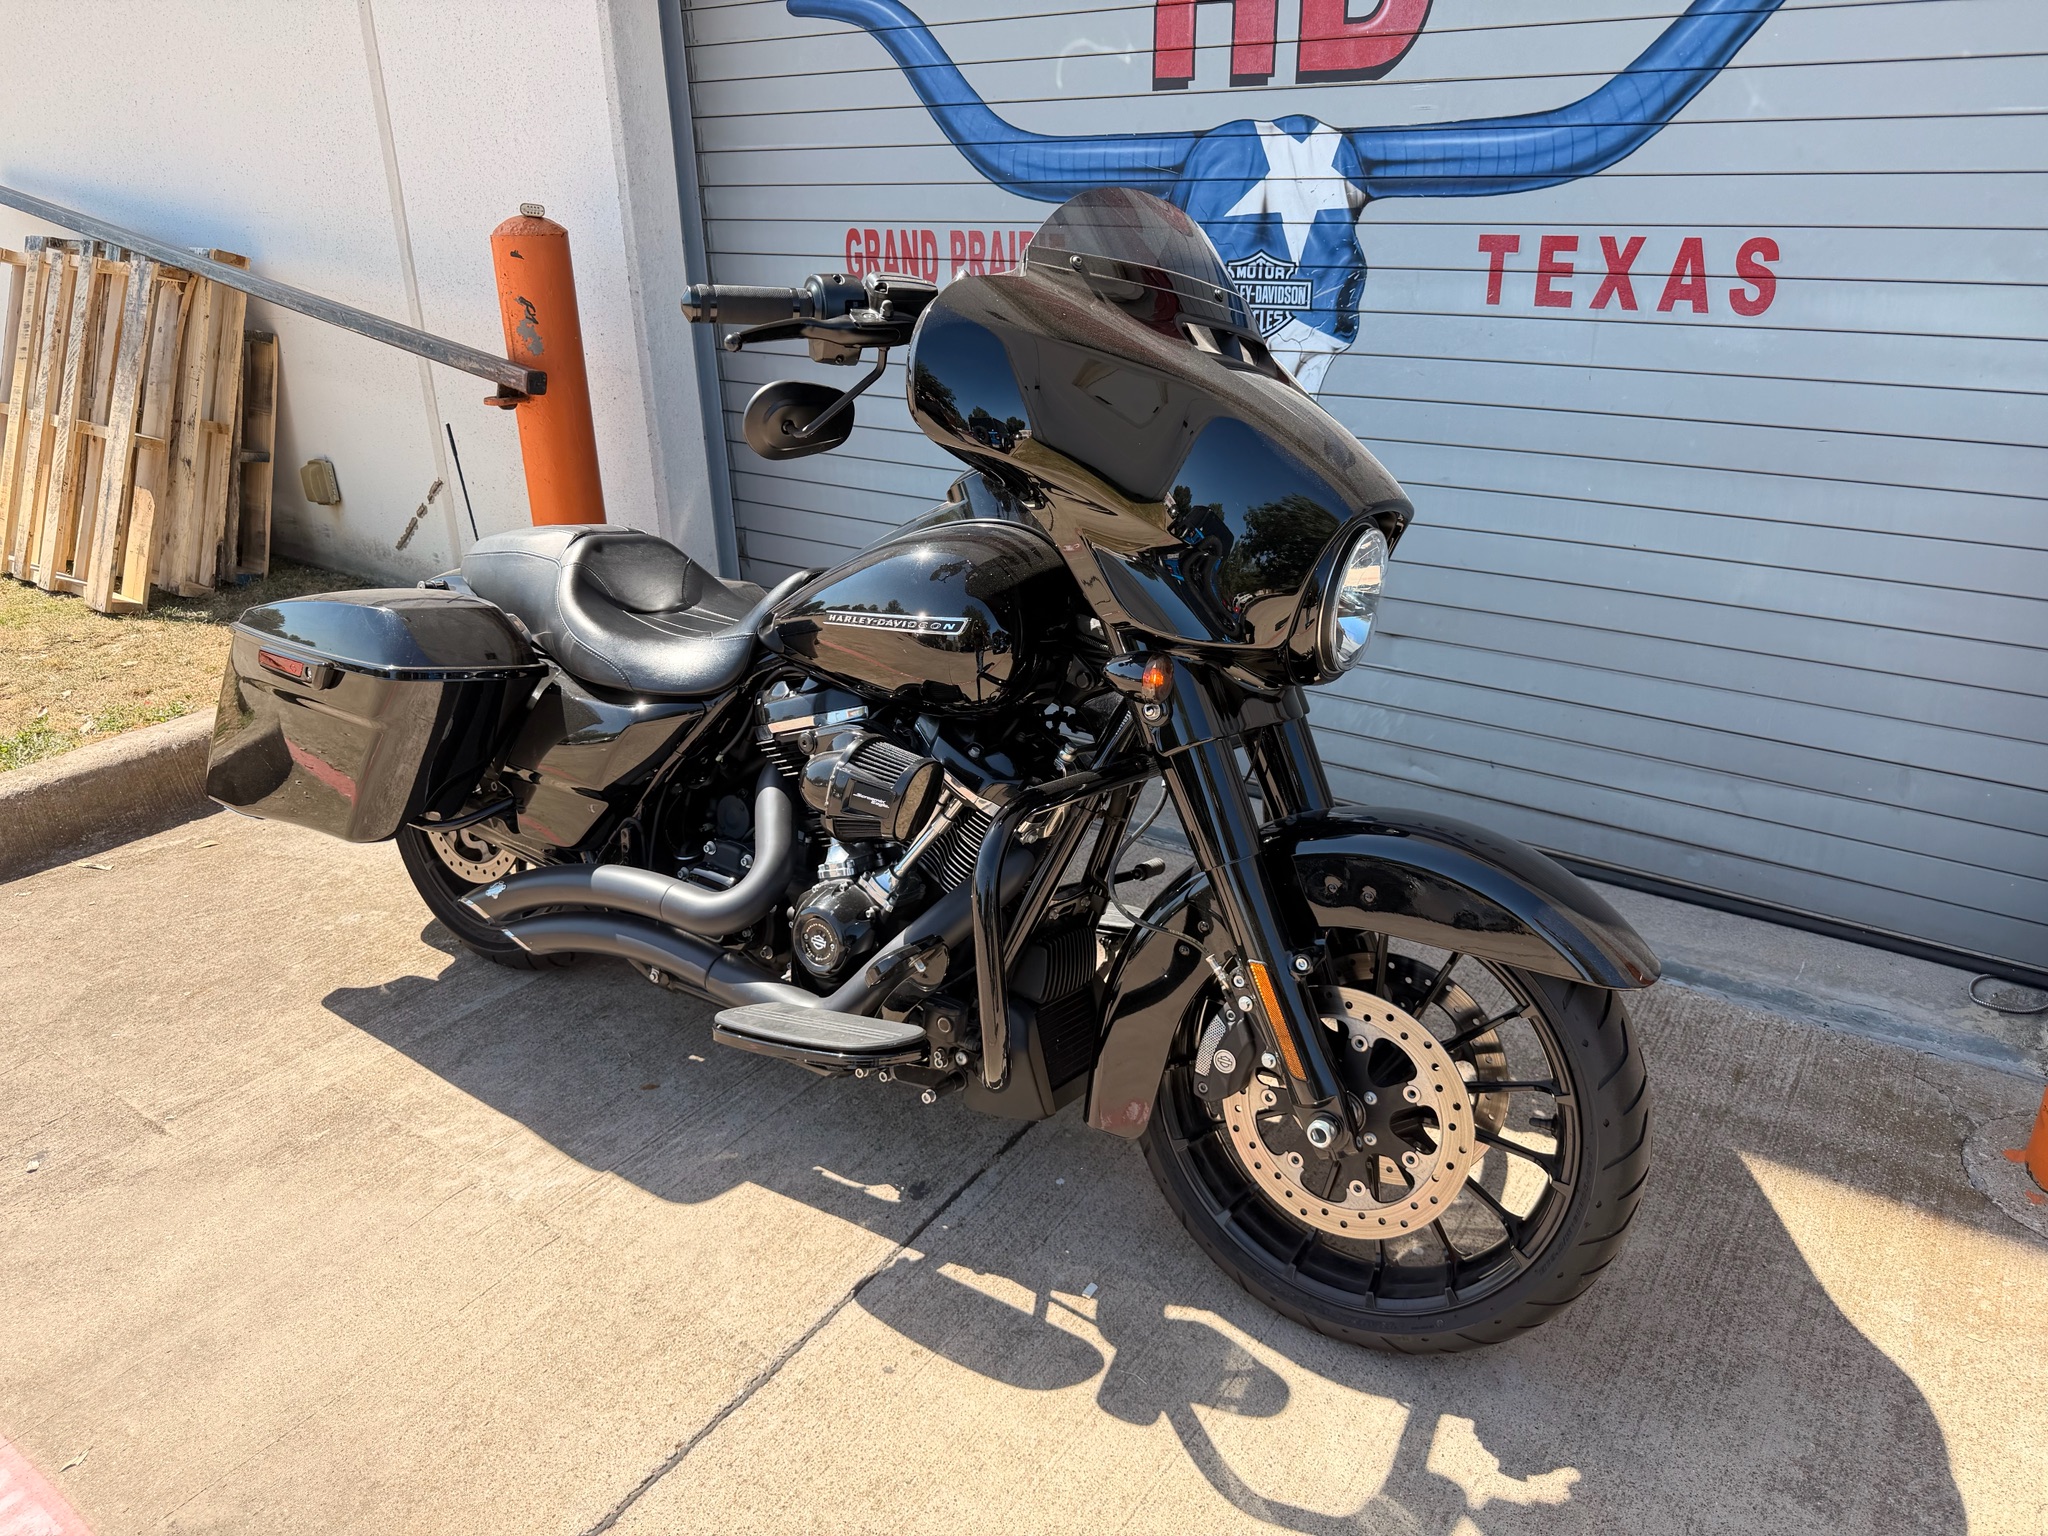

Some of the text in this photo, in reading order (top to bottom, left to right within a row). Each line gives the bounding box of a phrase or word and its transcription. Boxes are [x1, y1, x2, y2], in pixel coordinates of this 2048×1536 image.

[845, 227, 939, 285] GRAND
[1236, 261, 1287, 279] MOTOR
[1478, 235, 1780, 317] TEXAS
[1235, 285, 1306, 305] EY-DAVIDSON
[829, 614, 956, 630] HARLEY-DAVIDSON
